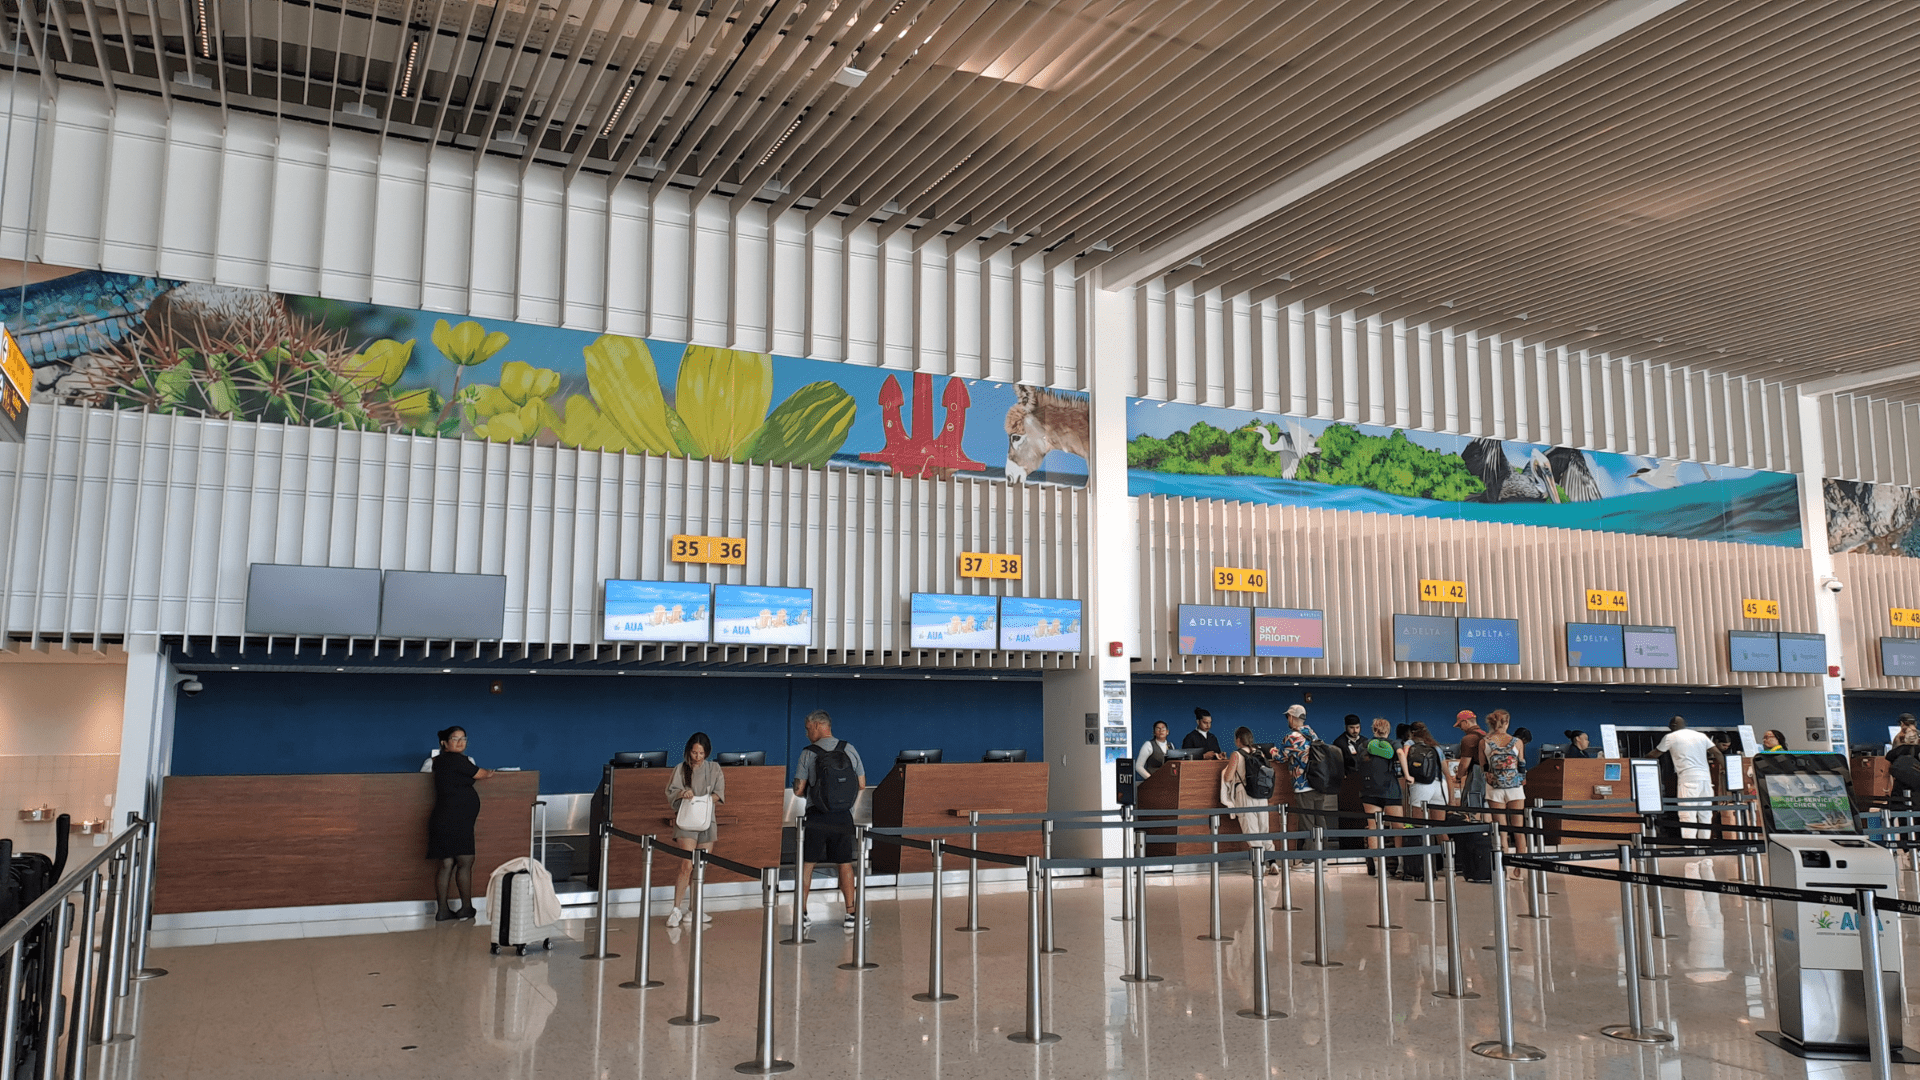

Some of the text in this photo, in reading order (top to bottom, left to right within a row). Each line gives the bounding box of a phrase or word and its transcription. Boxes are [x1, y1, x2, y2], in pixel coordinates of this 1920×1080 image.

[676, 540, 742, 559] 35 36
[964, 557, 1018, 574] 37 38
[1218, 572, 1264, 587] 39 40
[1424, 584, 1464, 598] 41 42
[1590, 594, 1625, 607] 43 44
[1746, 603, 1758, 615] 45
[1199, 617, 1233, 627] DELTA
[1893, 611, 1903, 623] 47
[624, 622, 644, 632] AUA
[732, 625, 751, 635] AUA
[1259, 625, 1278, 634] SKY
[1411, 627, 1441, 636] DELTA
[926, 631, 943, 640] AUA
[1015, 634, 1031, 643] AUA
[1259, 633, 1301, 643] PRIORITY
[1475, 629, 1504, 638] DELTA
[1582, 634, 1609, 643] DELTA
[1119, 773, 1133, 785] EXIT
[1637, 875, 1650, 884] AUA
[1726, 885, 1740, 894] AUA
[1829, 895, 1844, 904] AUA
